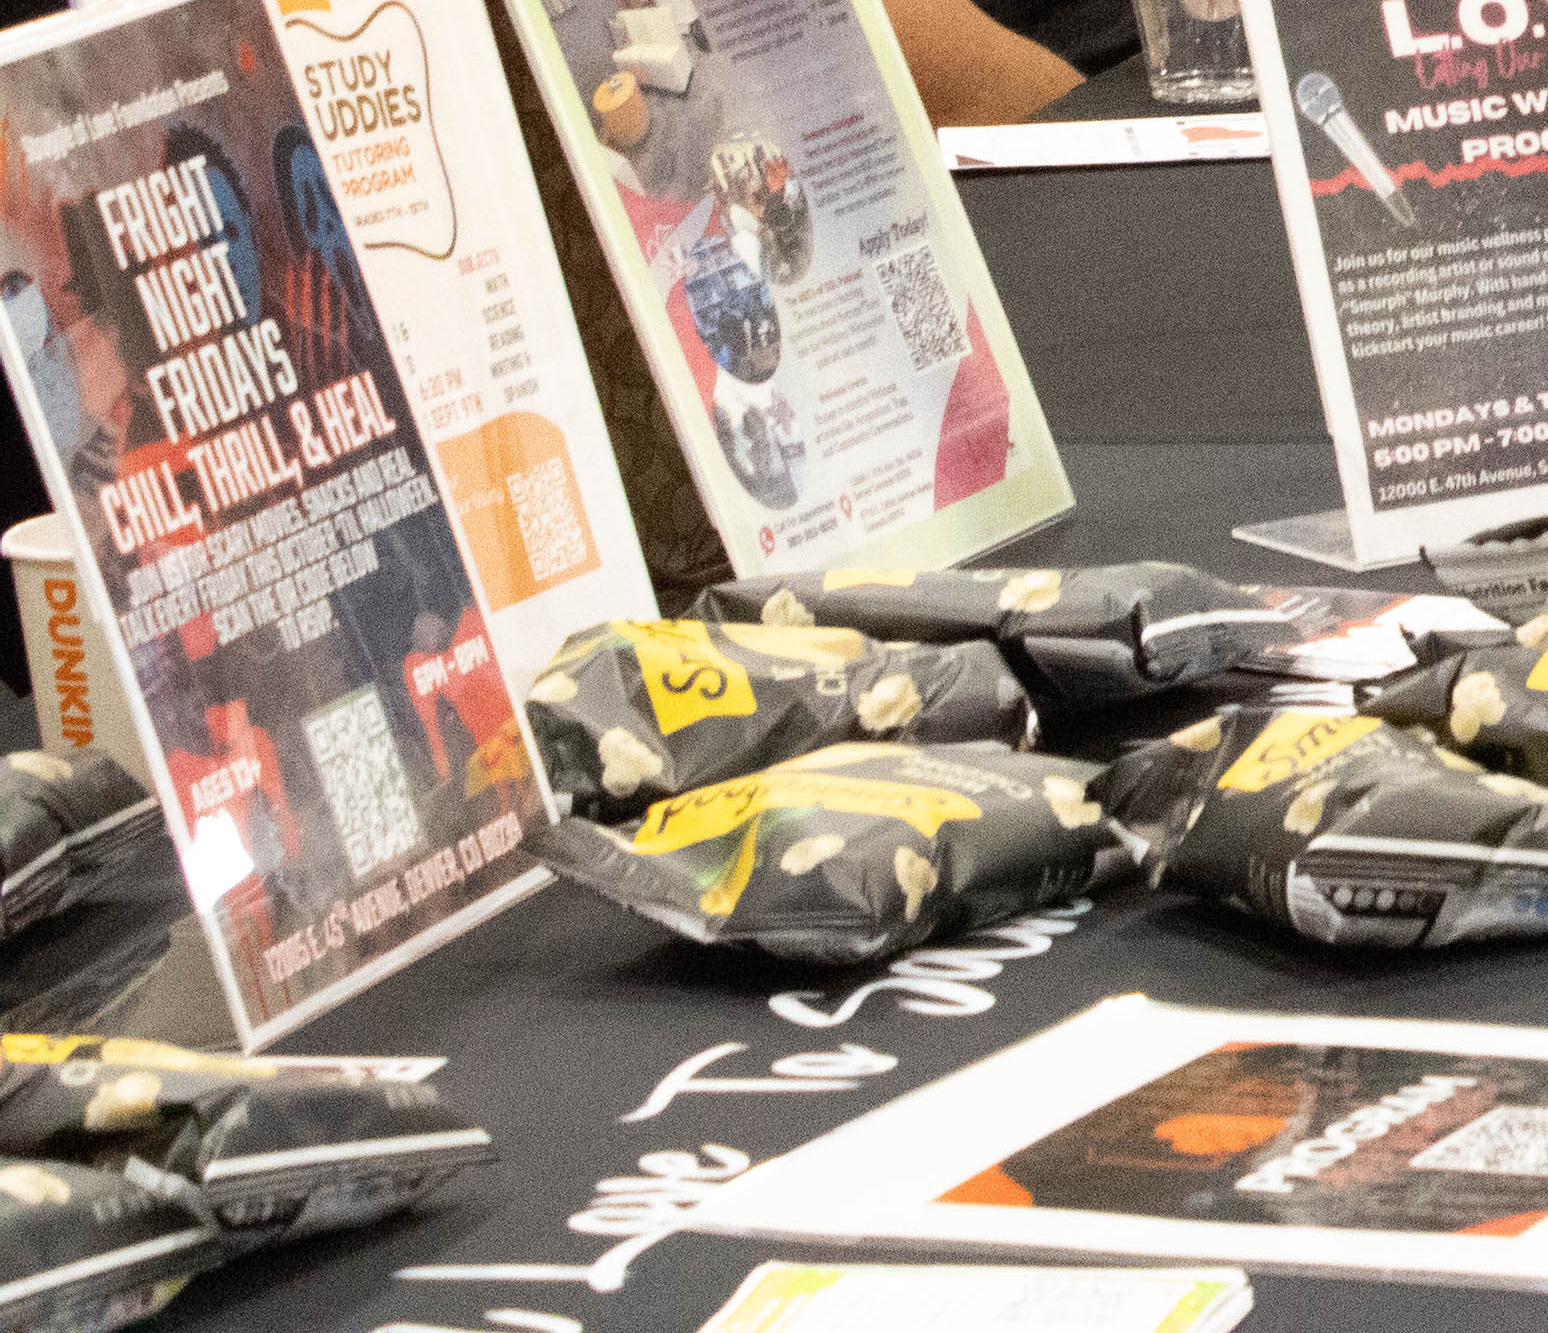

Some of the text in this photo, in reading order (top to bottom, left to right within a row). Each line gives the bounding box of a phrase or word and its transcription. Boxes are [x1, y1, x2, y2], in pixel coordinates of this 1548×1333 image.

[299, 39, 401, 107] STUDY
[312, 75, 426, 150] UDDIES
[1383, 94, 1509, 135] MUSIC
[330, 132, 412, 177] TUTORING
[340, 160, 418, 202] PROGRAM
[94, 153, 229, 271] FRIGHT
[1332, 252, 1366, 275] Join
[1367, 253, 1385, 267] us
[1385, 246, 1409, 264] for
[1409, 245, 1435, 260] our
[1435, 235, 1479, 256] music
[1480, 225, 1541, 249] wellness
[1337, 280, 1355, 294] as
[1356, 279, 1366, 291] a
[1367, 264, 1437, 293] recording
[1437, 258, 1476, 278] artist
[1478, 259, 1495, 272] or
[1496, 248, 1541, 269] sound
[133, 239, 251, 353] NIGHT
[1345, 316, 1400, 341] theory,
[1400, 310, 1439, 329] artist
[1440, 299, 1505, 326] branding
[1505, 295, 1535, 312] and
[1350, 336, 1414, 359] kickstart
[1415, 334, 1448, 352] your
[1449, 323, 1493, 343] music
[1494, 315, 1544, 335] career!
[147, 317, 300, 448] FRIDAYS
[1367, 398, 1511, 439] MONDAYS
[1513, 394, 1534, 414] &
[98, 365, 397, 569] CHILL, THRILL, & HEAL
[1373, 442, 1431, 468] 5:00
[1433, 434, 1481, 458] PM
[1444, 471, 1478, 493] 47th
[1477, 461, 1536, 487] Avenue,
[188, 764, 236, 816] AGES
[618, 1041, 899, 1125] To
[1212, 1074, 1495, 1193] PROGRAM
